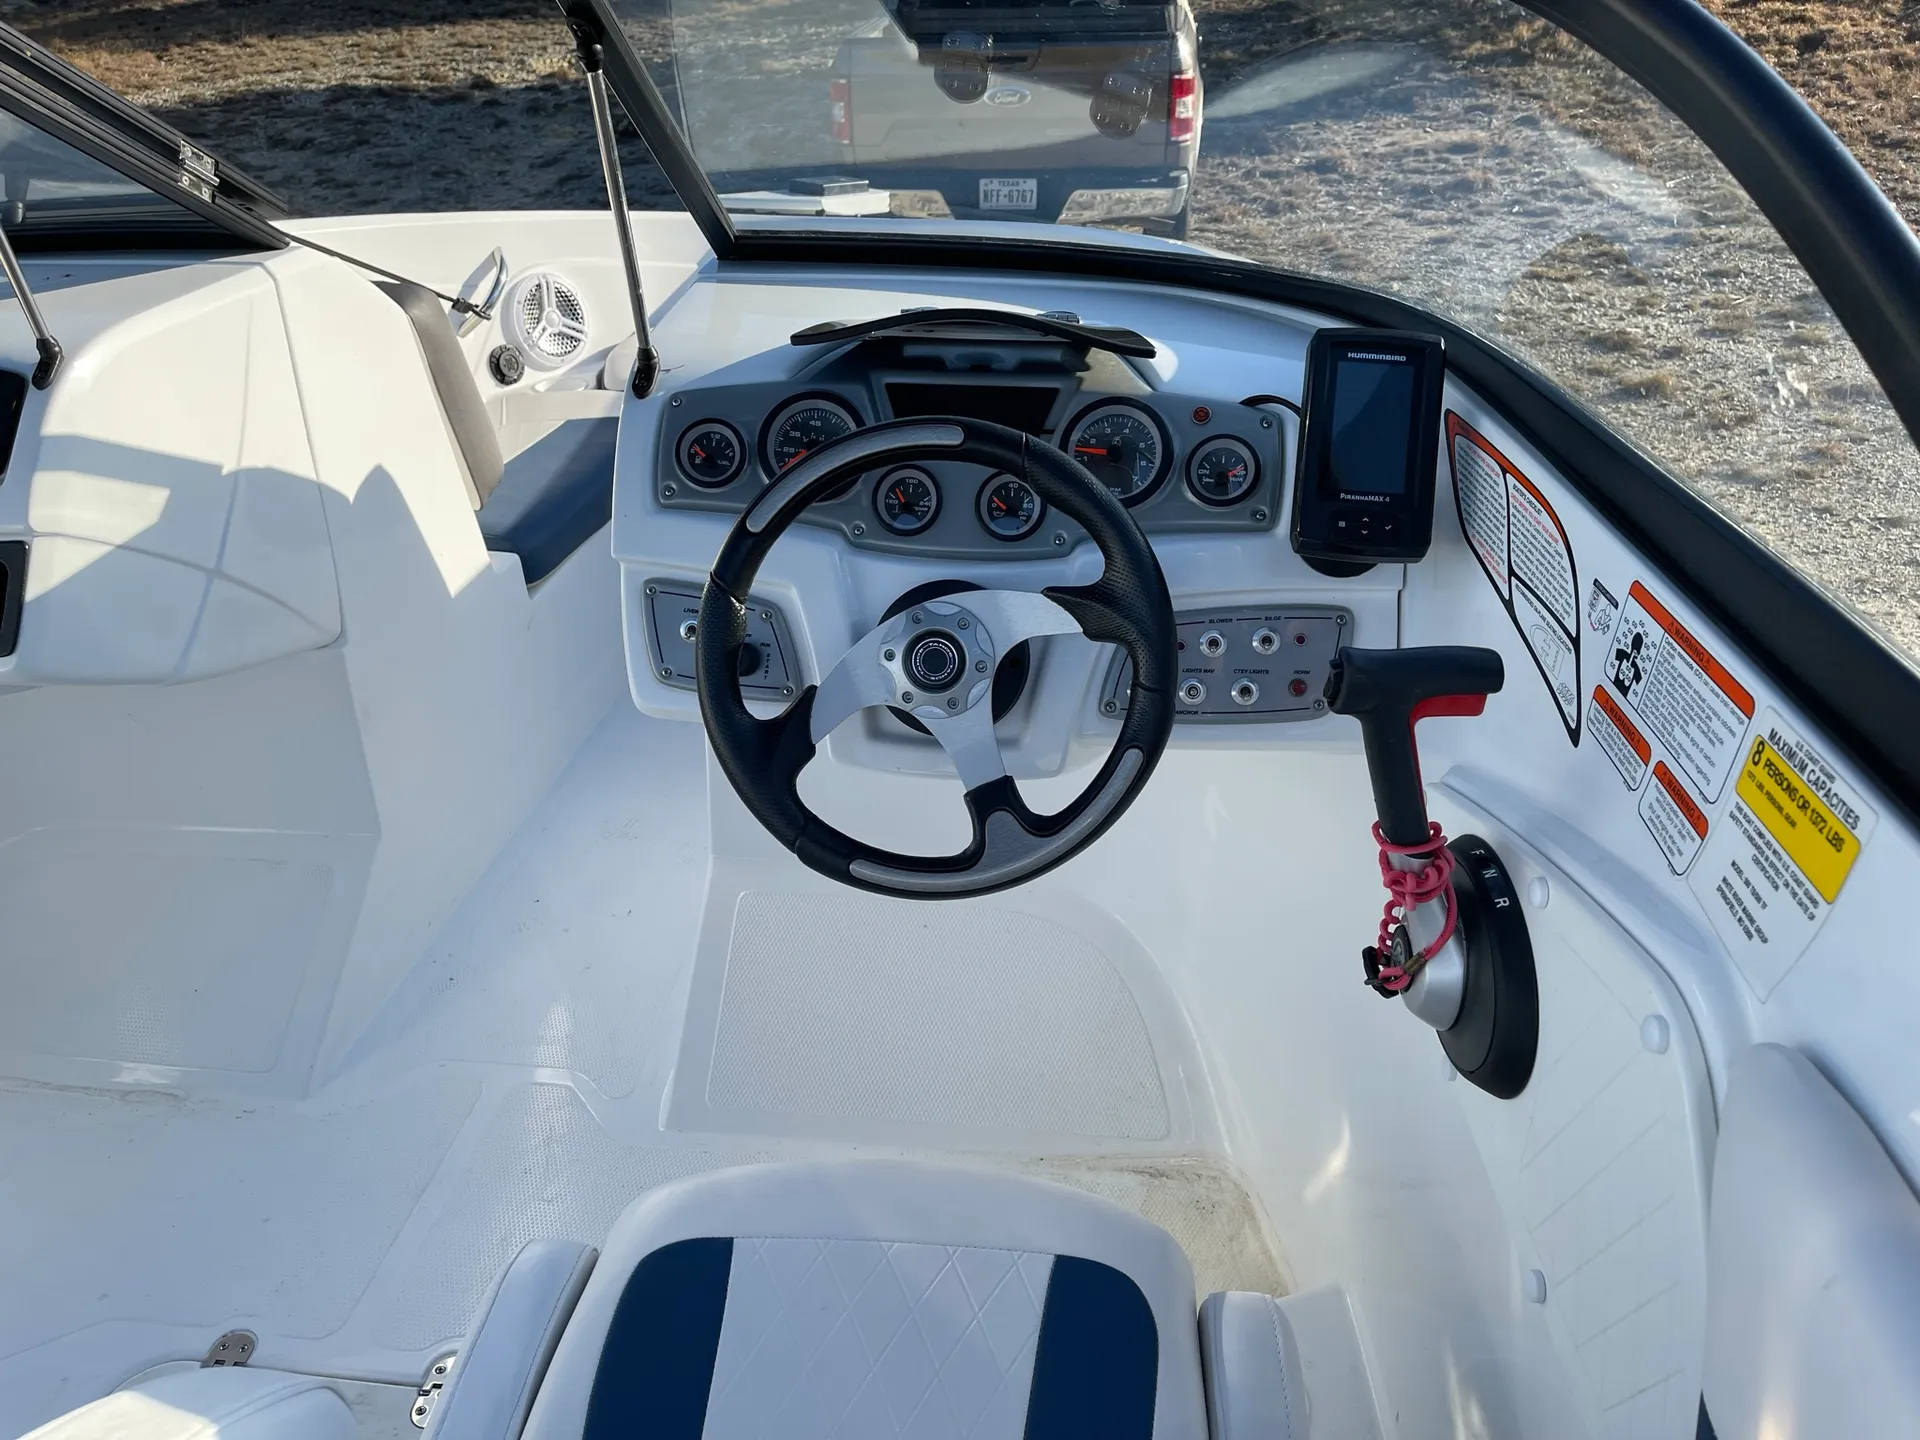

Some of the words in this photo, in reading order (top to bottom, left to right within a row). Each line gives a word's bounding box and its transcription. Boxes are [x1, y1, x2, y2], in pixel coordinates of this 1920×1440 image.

[1348, 352, 1406, 362] HUMMINBIRD
[1623, 615, 1629, 625] CO
[1631, 619, 1638, 629] CO
[1638, 618, 1644, 628] CO
[1622, 630, 1628, 640] CO
[1627, 626, 1633, 636] CO
[1642, 628, 1648, 639] CO
[1615, 635, 1621, 645] CO
[1623, 640, 1629, 650] CO
[1650, 639, 1657, 650] CO
[1673, 626, 1704, 662] WARNING
[1643, 641, 1650, 651] CO
[1639, 653, 1646, 664] CO
[1645, 653, 1652, 663] CO
[1609, 660, 1615, 670] CO
[1625, 664, 1632, 674] CO
[1641, 665, 1647, 675] CO
[1620, 667, 1626, 677] CO
[1625, 673, 1631, 682] CO
[1658, 650, 1671, 668] Engine
[1676, 670, 1693, 692] generator
[1692, 686, 1706, 705] exhaust
[1705, 701, 1721, 722] contains
[1664, 636, 1678, 654] Carbon
[1676, 649, 1694, 672] monoxide
[1693, 667, 1703, 682] (CO)
[1709, 685, 1720, 700] cause
[1719, 695, 1730, 710] brain
[1728, 706, 1745, 727] damage
[1632, 687, 1638, 698] CO
[1667, 679, 1679, 695] carbon
[1678, 691, 1695, 713] monoxide
[1677, 680, 1689, 697] carbon
[1688, 693, 1706, 715] monoxide
[1608, 703, 1637, 743] WARNING
[1639, 705, 1650, 722] carbon
[1650, 718, 1665, 740] monoxide
[1803, 748, 1820, 768] COAST
[1818, 763, 1836, 785] GUARD
[1767, 726, 1808, 777] MAXIMUM
[1805, 766, 1861, 831] CAPACITIES
[1666, 776, 1696, 818] WARNING
[1750, 738, 1766, 768] 8
[1762, 756, 1800, 803] PERSONS
[1795, 792, 1812, 816] OR
[1807, 806, 1828, 834] 1372
[1824, 825, 1846, 854] LBS
[1783, 811, 1797, 830] GEAR
[1734, 800, 1744, 816] THIS
[1742, 810, 1754, 828] BOAT
[1752, 823, 1773, 851] COMPLIES
[1771, 846, 1783, 864] WITH
[1788, 869, 1805, 892] COAST
[1802, 886, 1820, 911] GUARD
[1728, 809, 1744, 831] SAFETY
[1741, 826, 1765, 858] STANDARDS
[1767, 859, 1784, 882] EFFECT
[1782, 877, 1790, 890] ON
[1788, 885, 1799, 901] THE
[1796, 895, 1810, 915] DATE
[1806, 909, 1816, 923] OF
[1482, 869, 1498, 878] N
[1750, 852, 1780, 892] CERTIFICATION
[1494, 897, 1510, 908] R
[1721, 875, 1734, 894] WHITE
[1731, 889, 1744, 909] RIVER
[1740, 903, 1757, 928] MARINE
[1753, 923, 1769, 946] GROUP
[1736, 913, 1745, 928] MO
